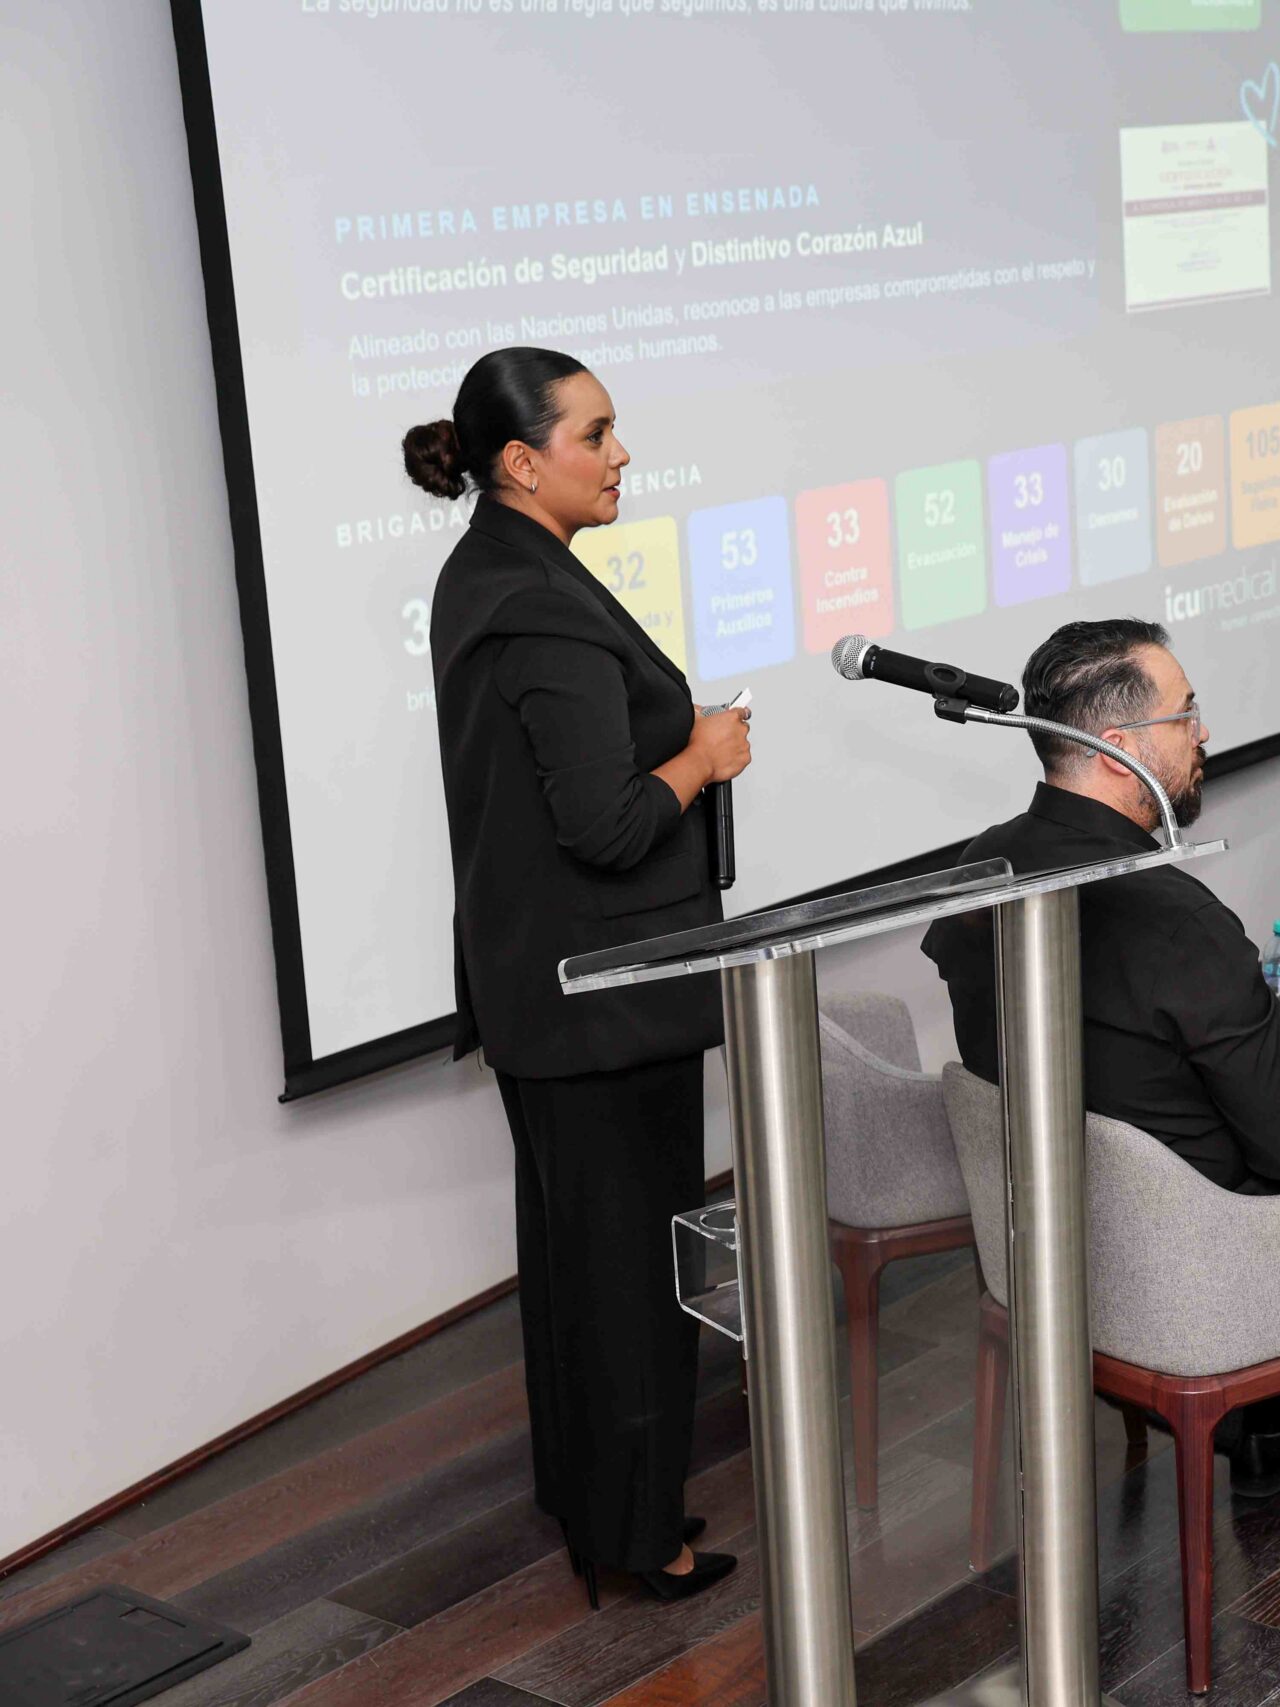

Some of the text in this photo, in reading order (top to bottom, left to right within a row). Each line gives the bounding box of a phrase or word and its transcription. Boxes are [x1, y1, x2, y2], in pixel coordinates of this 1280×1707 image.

[339, 0, 447, 18] seguridad
[455, 0, 482, 13] no
[490, 0, 514, 13] es
[520, 0, 558, 13] una
[563, 0, 614, 18] regla
[620, 0, 653, 18] que
[660, 0, 751, 18] seguimos,
[757, 0, 778, 12] es
[783, 0, 815, 12] una
[820, 0, 875, 12] cultura
[880, 0, 908, 16] que
[912, 0, 973, 12] vivimos.
[334, 183, 821, 244] PRIMERA EMPRESA EN ENSENADA
[341, 220, 924, 300] Certificación de Seguridad y Distintivo Corazón Azul
[348, 258, 1096, 361] Alineado con las Naciones Unidas, reconoce a las empresas comprometidas con el respeto y
[351, 372, 371, 397] la
[638, 333, 724, 360] humanos.
[1176, 441, 1203, 476] 20
[1246, 425, 1280, 460] 105
[1013, 471, 1044, 508] 33
[1098, 454, 1126, 492] 30
[923, 488, 956, 528] 52
[826, 506, 861, 548] 33
[721, 527, 759, 570] 53
[907, 541, 977, 570] Evacuación
[607, 550, 646, 592] 32
[823, 565, 869, 589] Contra
[710, 586, 776, 613] Primeros
[815, 587, 879, 614] Incendios
[715, 611, 773, 638] Auxilios
